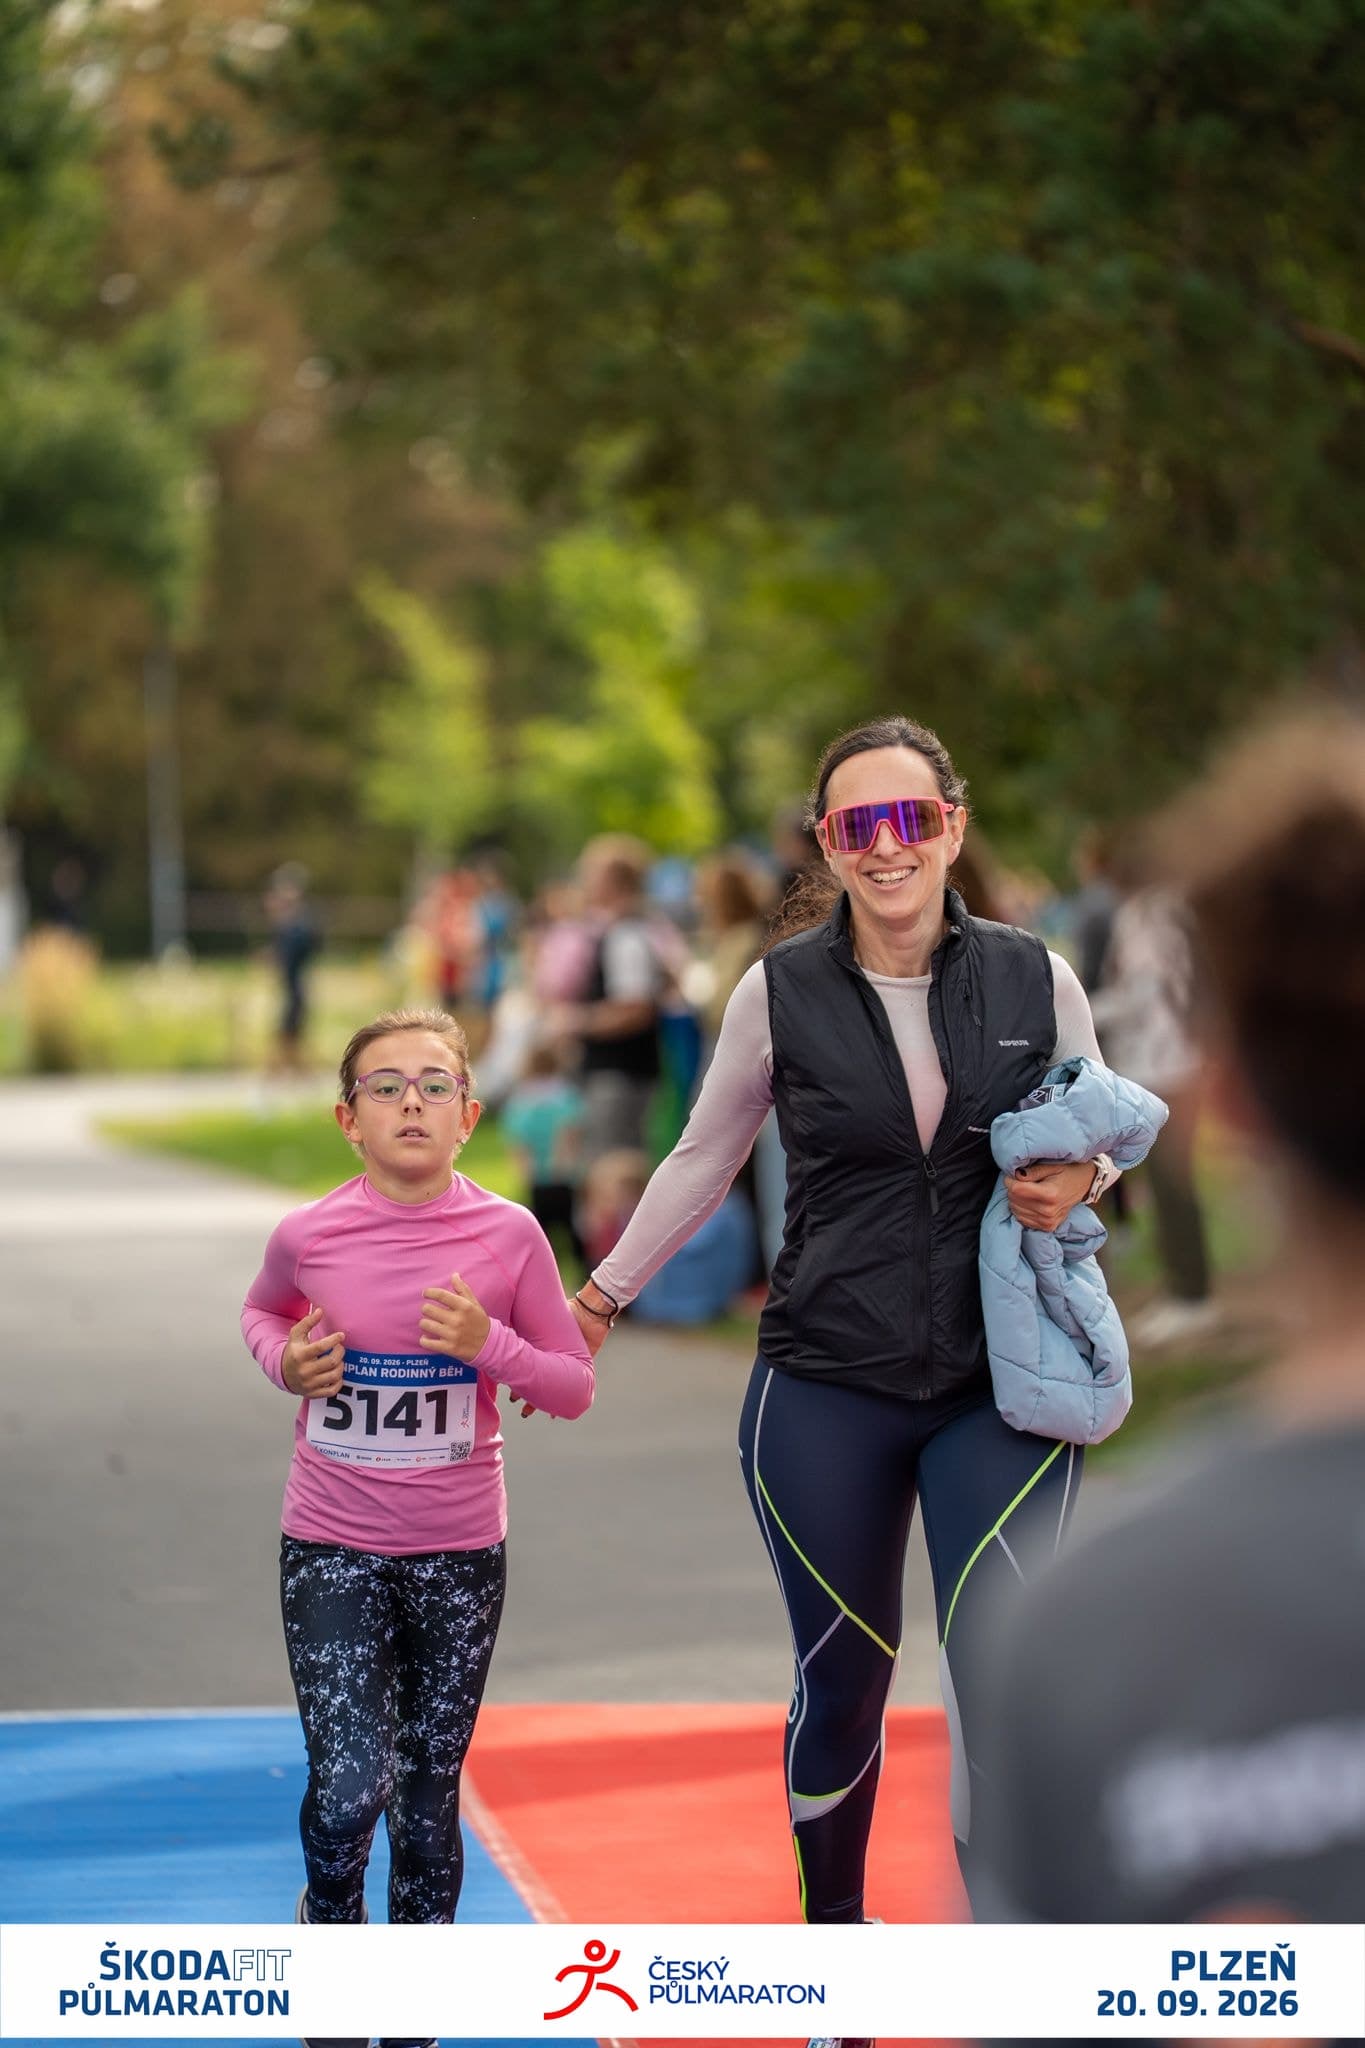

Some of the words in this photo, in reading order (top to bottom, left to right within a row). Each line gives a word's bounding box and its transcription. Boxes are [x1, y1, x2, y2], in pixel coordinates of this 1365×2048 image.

[359, 1356, 370, 1364] 20.
[383, 1358, 401, 1366] 2026
[344, 1362, 377, 1377] NPLAN
[381, 1366, 436, 1379] RODINNÝ
[438, 1365, 463, 1378] BĚH
[323, 1385, 448, 1437] 5141
